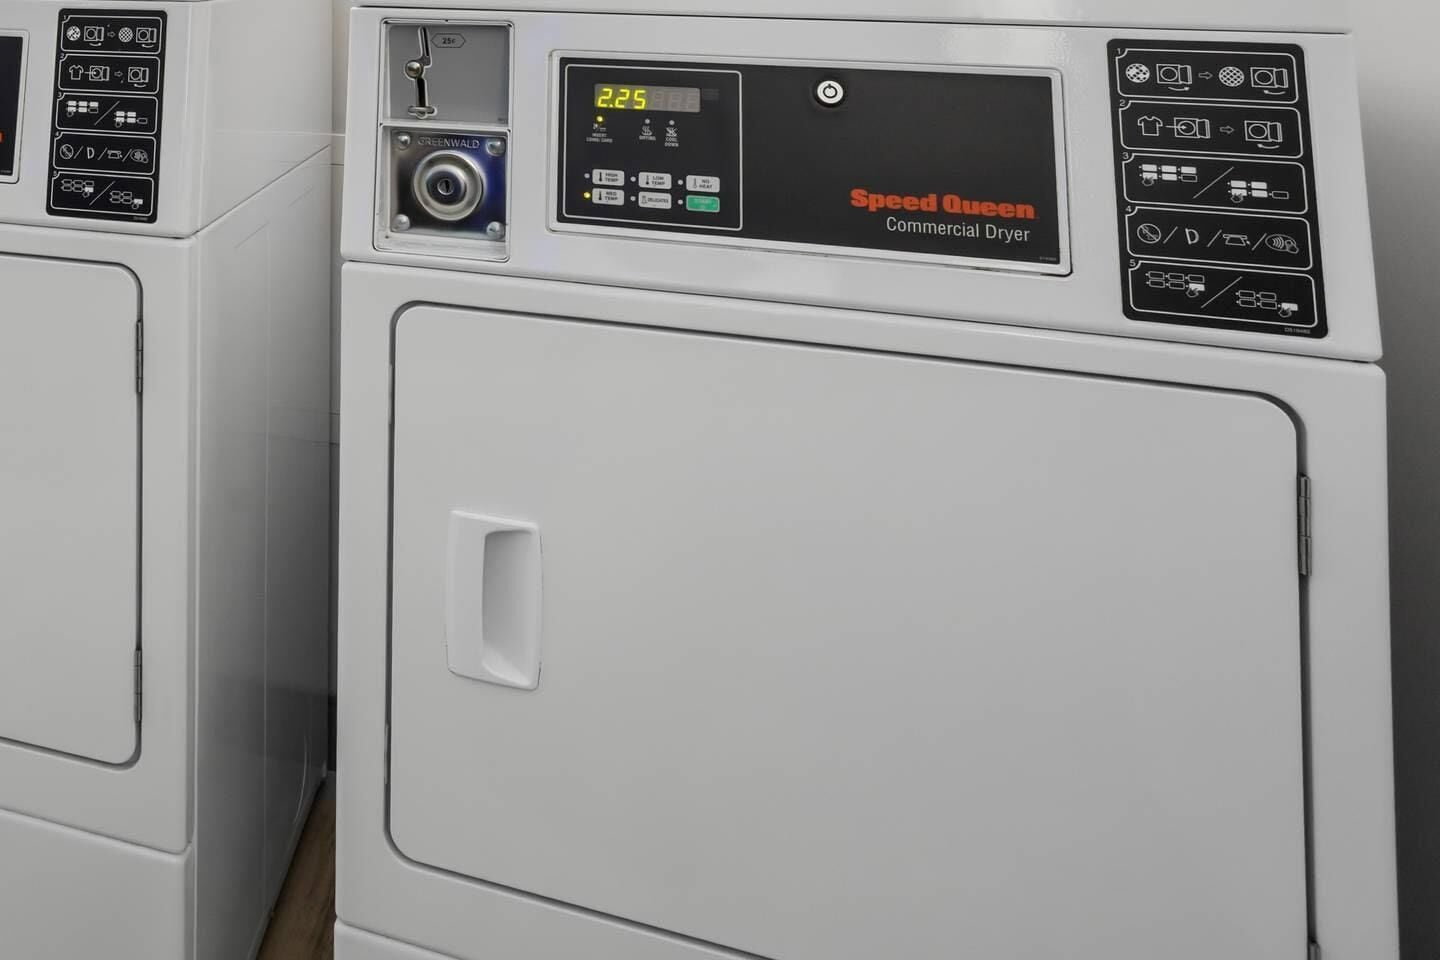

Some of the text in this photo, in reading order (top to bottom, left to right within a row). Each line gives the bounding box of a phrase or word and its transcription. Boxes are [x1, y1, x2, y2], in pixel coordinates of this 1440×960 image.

[597, 88, 646, 109] 2.25
[417, 137, 480, 149] GREENWALD
[850, 189, 1035, 219] Speed Queen
[886, 216, 1031, 243] Commercial Dryer
[1130, 259, 1136, 267] 5
